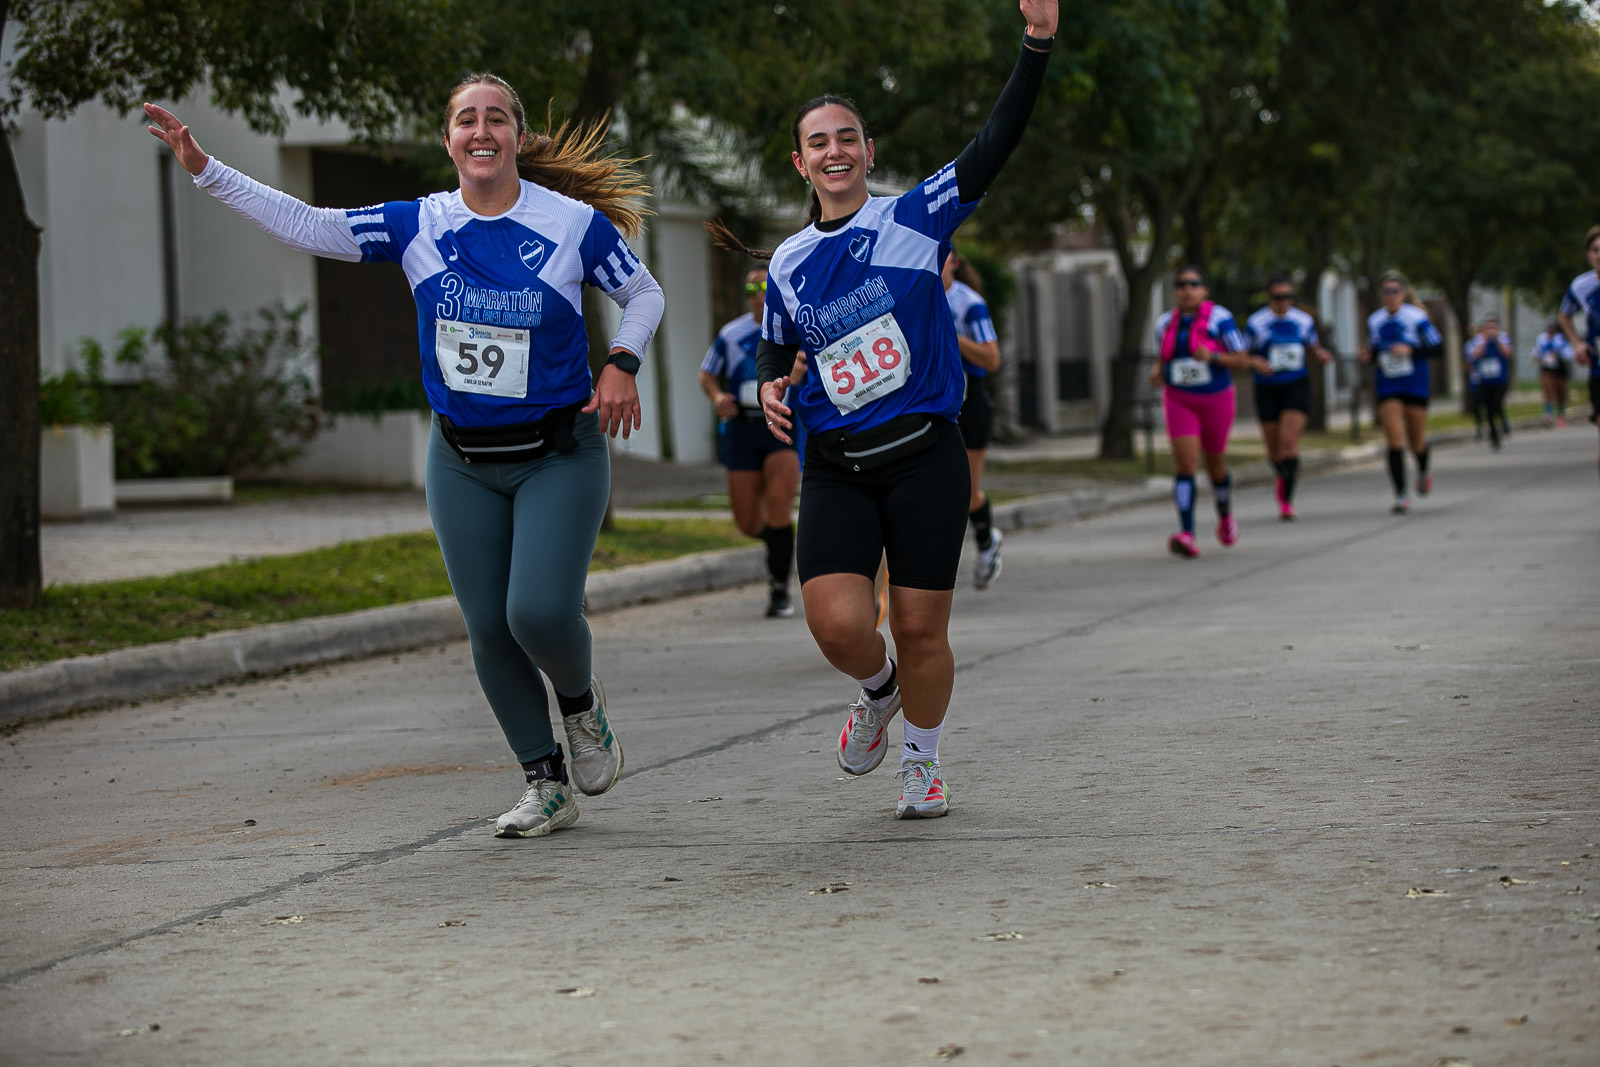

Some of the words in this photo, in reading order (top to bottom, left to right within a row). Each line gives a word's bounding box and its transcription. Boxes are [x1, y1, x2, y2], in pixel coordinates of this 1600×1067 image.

[437, 272, 464, 322] 3
[464, 287, 542, 312] MARATÓN
[798, 303, 827, 350] 3
[816, 276, 889, 328] MARATÓN
[469, 327, 475, 339] 3
[455, 342, 505, 379] 59
[831, 338, 901, 395] 518
